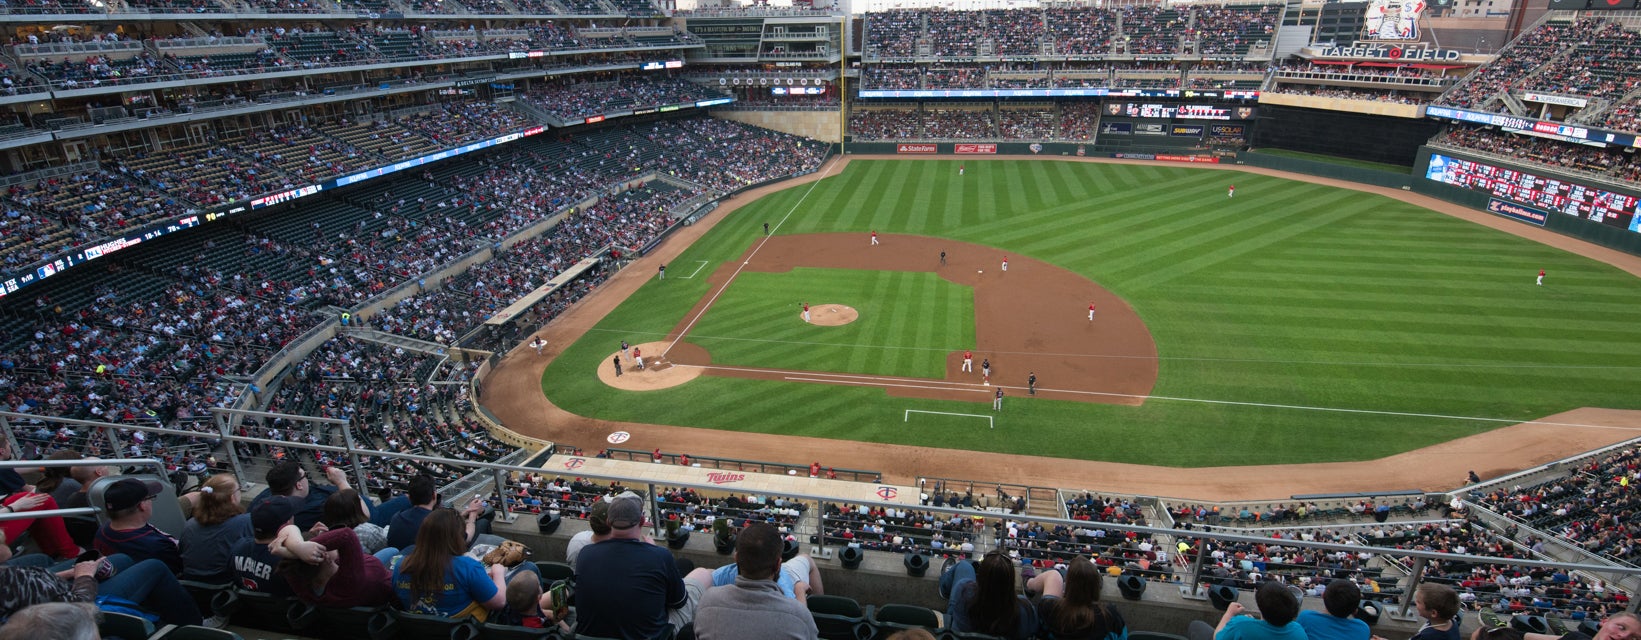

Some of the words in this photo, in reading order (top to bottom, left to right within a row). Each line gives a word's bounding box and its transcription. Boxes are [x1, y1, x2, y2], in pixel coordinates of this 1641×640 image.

[1321, 47, 1387, 58] TARGET
[1405, 48, 1460, 60] FIELD
[1541, 96, 1580, 105] SUPERAMERICA
[205, 212, 217, 222] 90
[101, 237, 126, 250] HUGHES
[4, 278, 16, 288] TEX
[706, 472, 745, 484] Twins
[234, 556, 272, 580] MAUER
